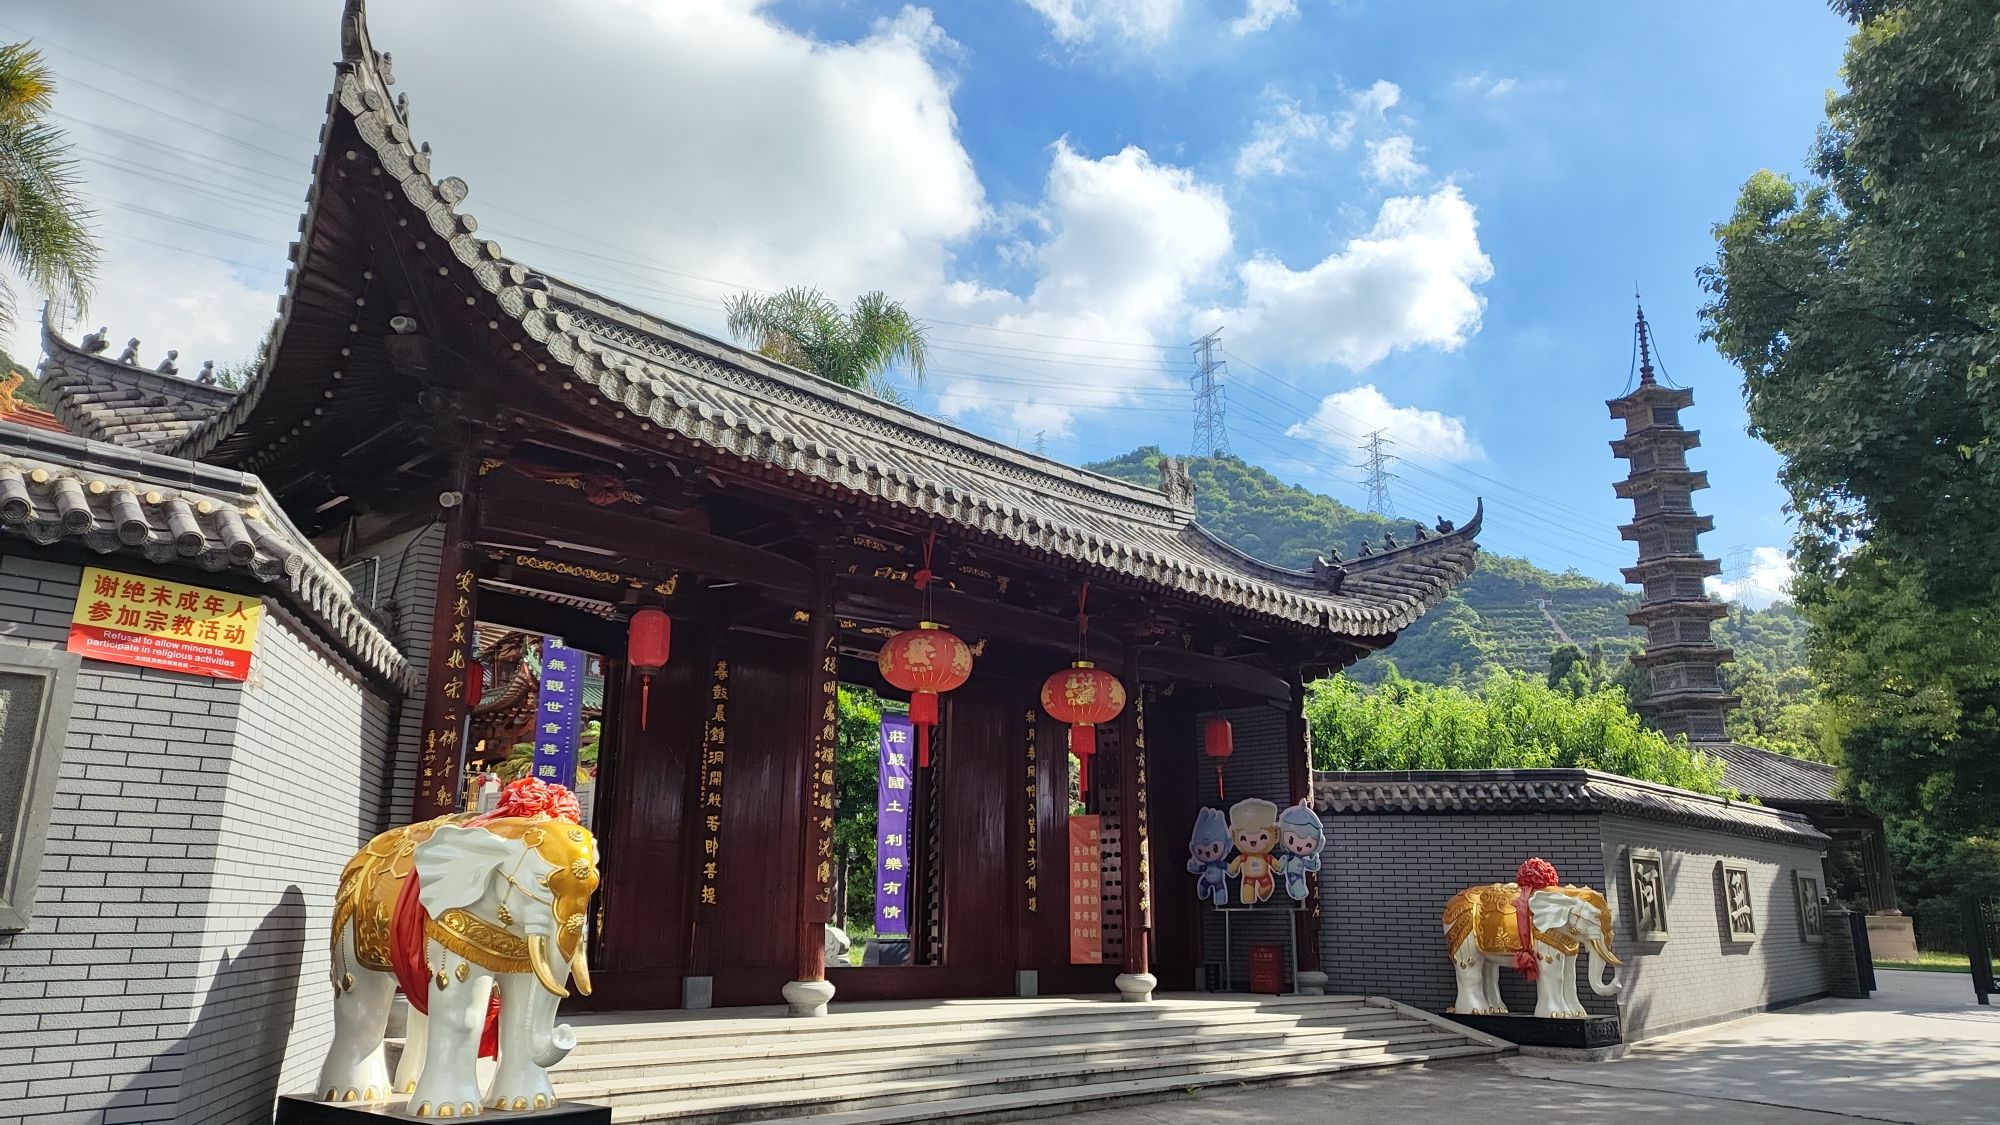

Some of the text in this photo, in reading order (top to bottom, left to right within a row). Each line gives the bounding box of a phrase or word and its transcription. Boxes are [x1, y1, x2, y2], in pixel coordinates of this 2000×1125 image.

[93, 573, 248, 621] 谢绝未成年人
[87, 600, 246, 645] 参加宗教活动
[86, 638, 139, 652] participate
[142, 644, 150, 654] in
[152, 647, 193, 661] religious
[194, 653, 236, 667] activities
[103, 630, 224, 656] Refusal to allow minors to
